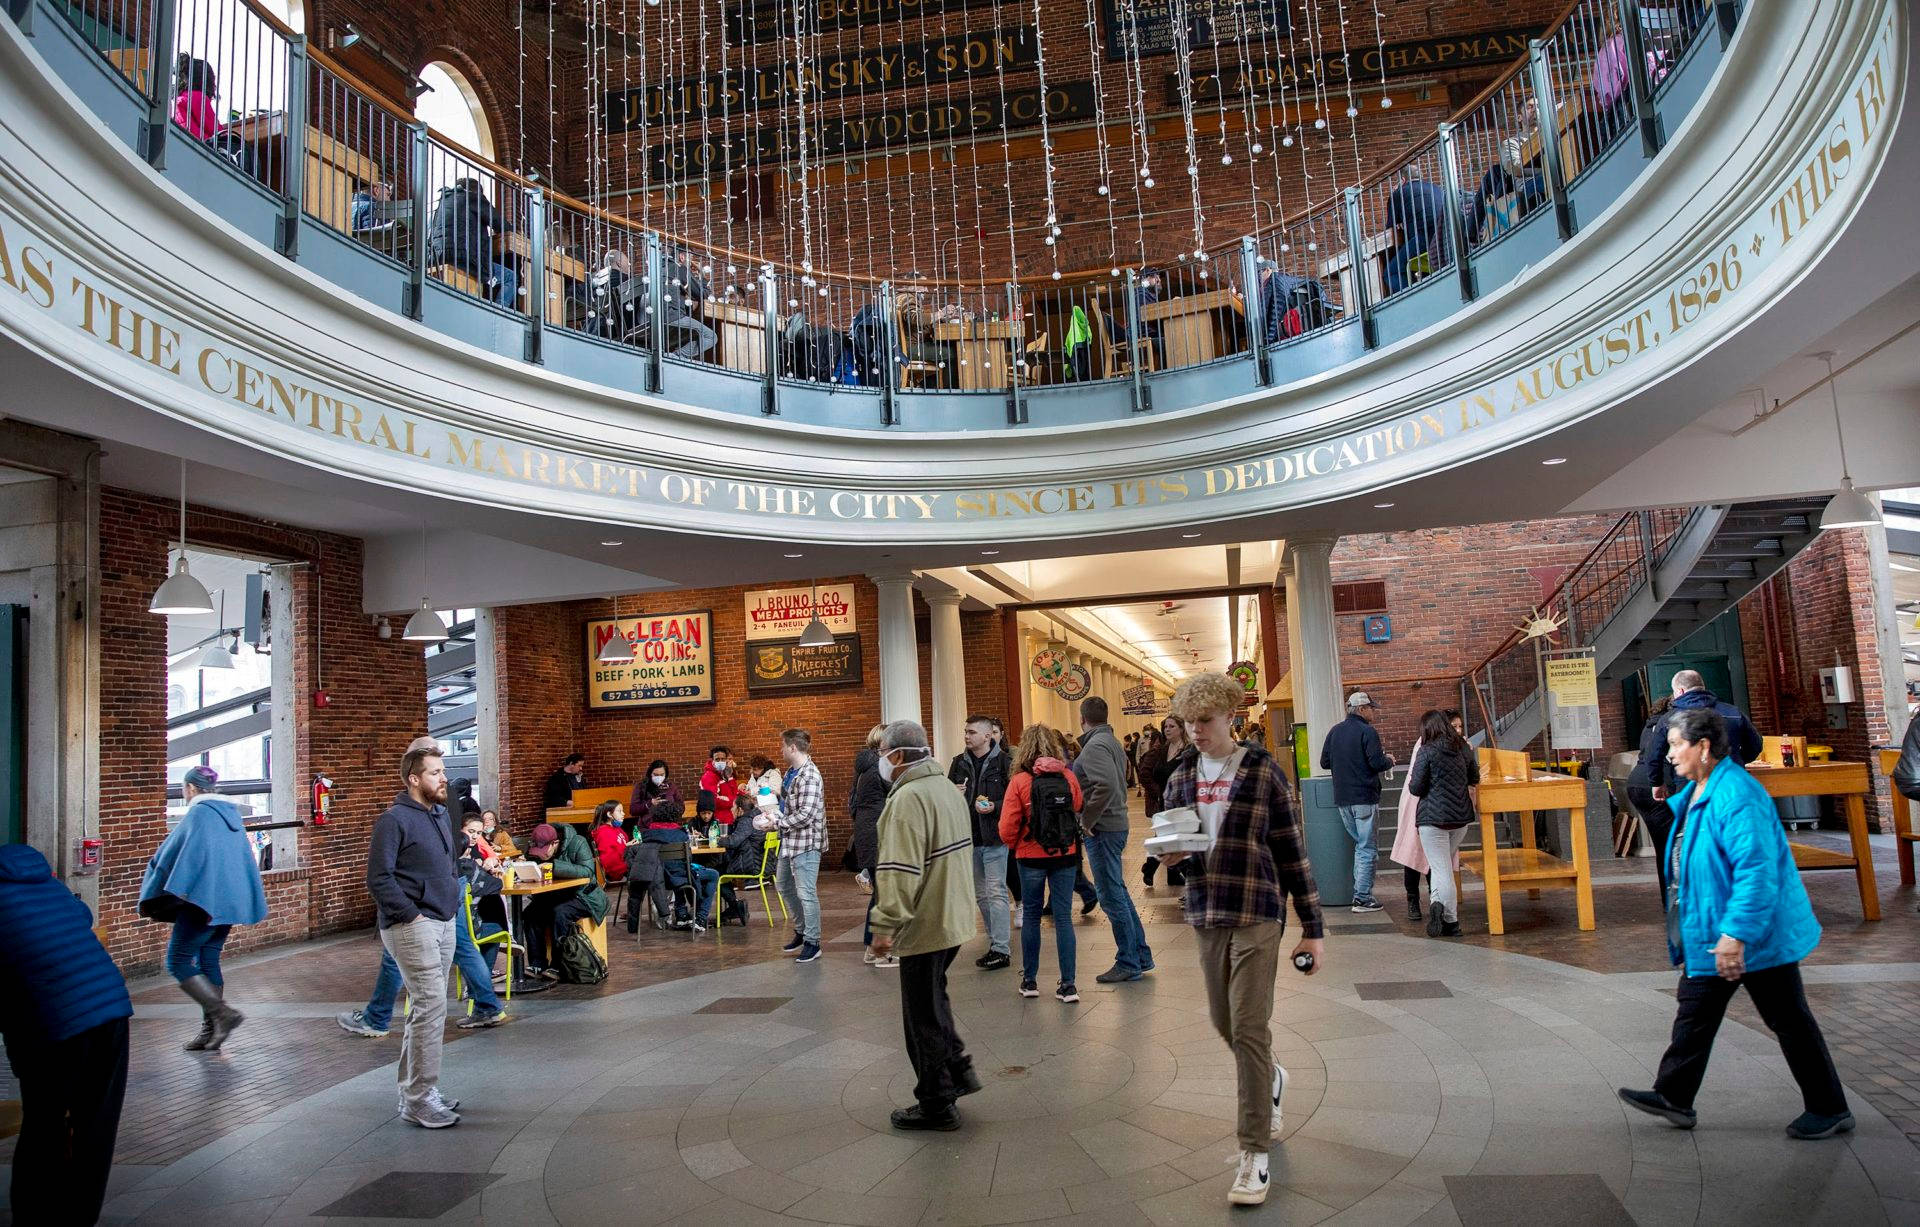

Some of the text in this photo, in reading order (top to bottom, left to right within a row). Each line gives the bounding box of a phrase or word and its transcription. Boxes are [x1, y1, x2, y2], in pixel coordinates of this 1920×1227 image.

[1232, 57, 1346, 90] ADAMS
[1362, 34, 1529, 72] CHAPMAN
[621, 35, 1015, 124] JULIUS LANSKY & SON
[1010, 89, 1078, 119] CO.
[71, 276, 181, 375] THE
[197, 346, 431, 460] CENTRAL
[445, 431, 648, 498] MARKET
[659, 473, 717, 506] OF
[728, 482, 816, 517] THE
[829, 491, 941, 520] CITY
[955, 484, 1095, 521] SINCE
[1110, 474, 1190, 508] ITS
[1203, 406, 1446, 498] DEDICATION
[1456, 387, 1496, 432] IN
[1509, 308, 1665, 414] AUGUST,
[1668, 242, 1743, 336] 1826
[1770, 116, 1853, 250] THIS
[768, 593, 809, 610] BRUNO
[822, 591, 842, 605] CO.
[753, 623, 767, 631] 2-4
[773, 620, 805, 630] FANEUIL
[833, 617, 849, 626] 6-8
[756, 610, 788, 621] MEAT
[791, 644, 852, 656] EMPIRE FRUIT CO.
[595, 664, 705, 683] BEEF PORK LAMB
[791, 654, 849, 675] APPLECREST
[608, 687, 692, 700] 57 59 60 62
[631, 681, 668, 690] STALLS
